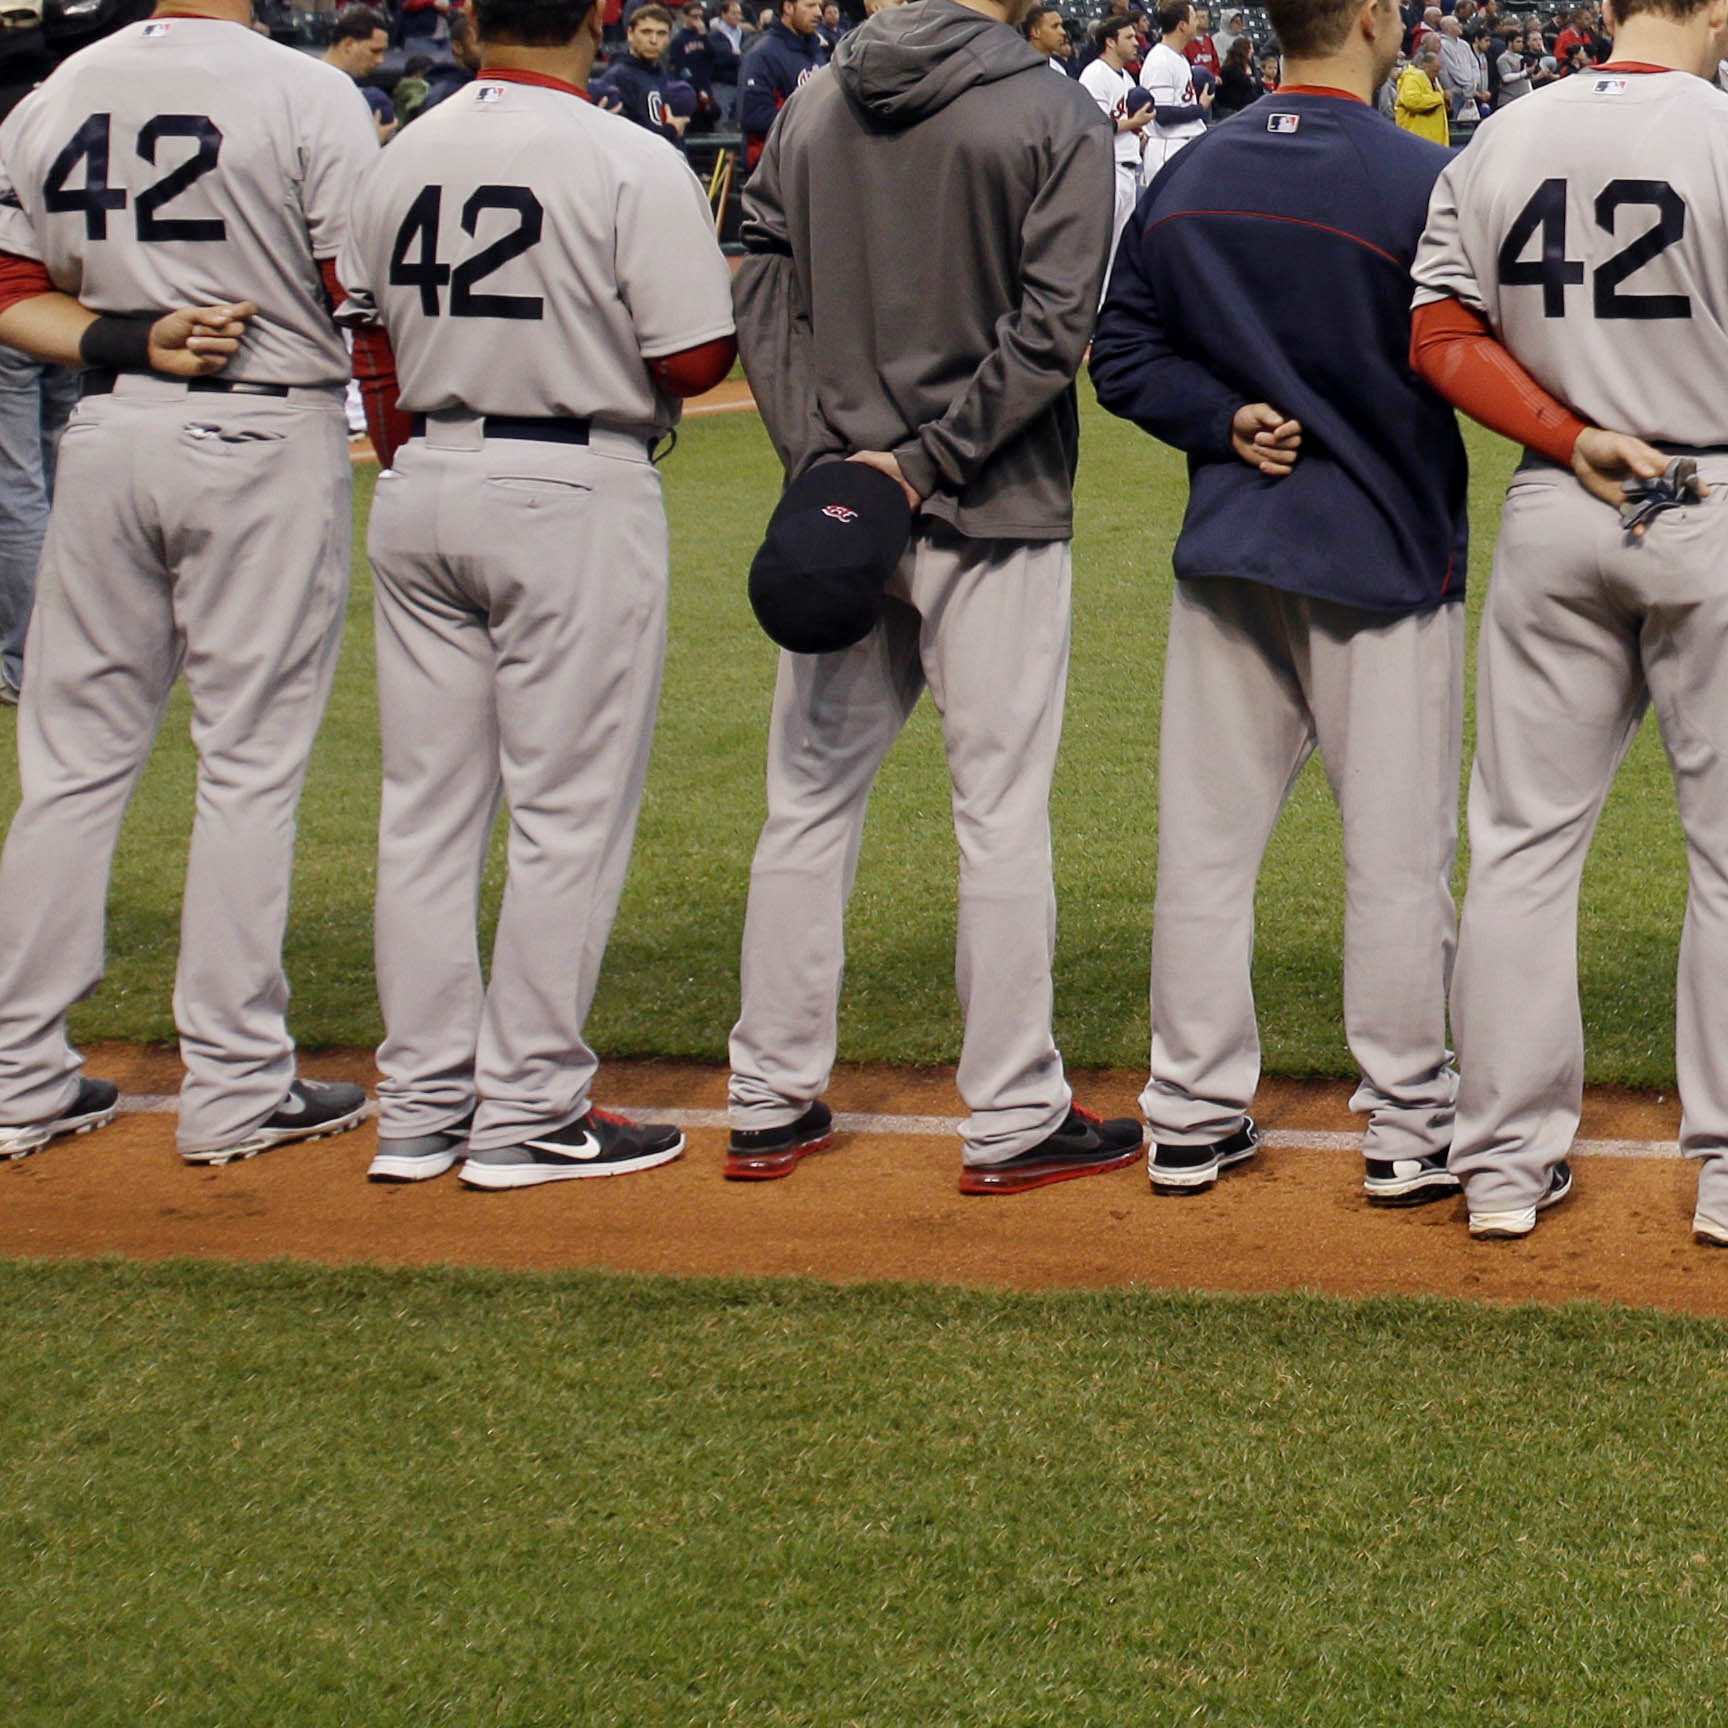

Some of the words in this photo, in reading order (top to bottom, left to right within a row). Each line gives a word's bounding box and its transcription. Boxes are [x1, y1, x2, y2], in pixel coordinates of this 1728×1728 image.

[43, 112, 226, 243] 42
[389, 182, 545, 321] 42
[1498, 177, 1692, 320] 42
